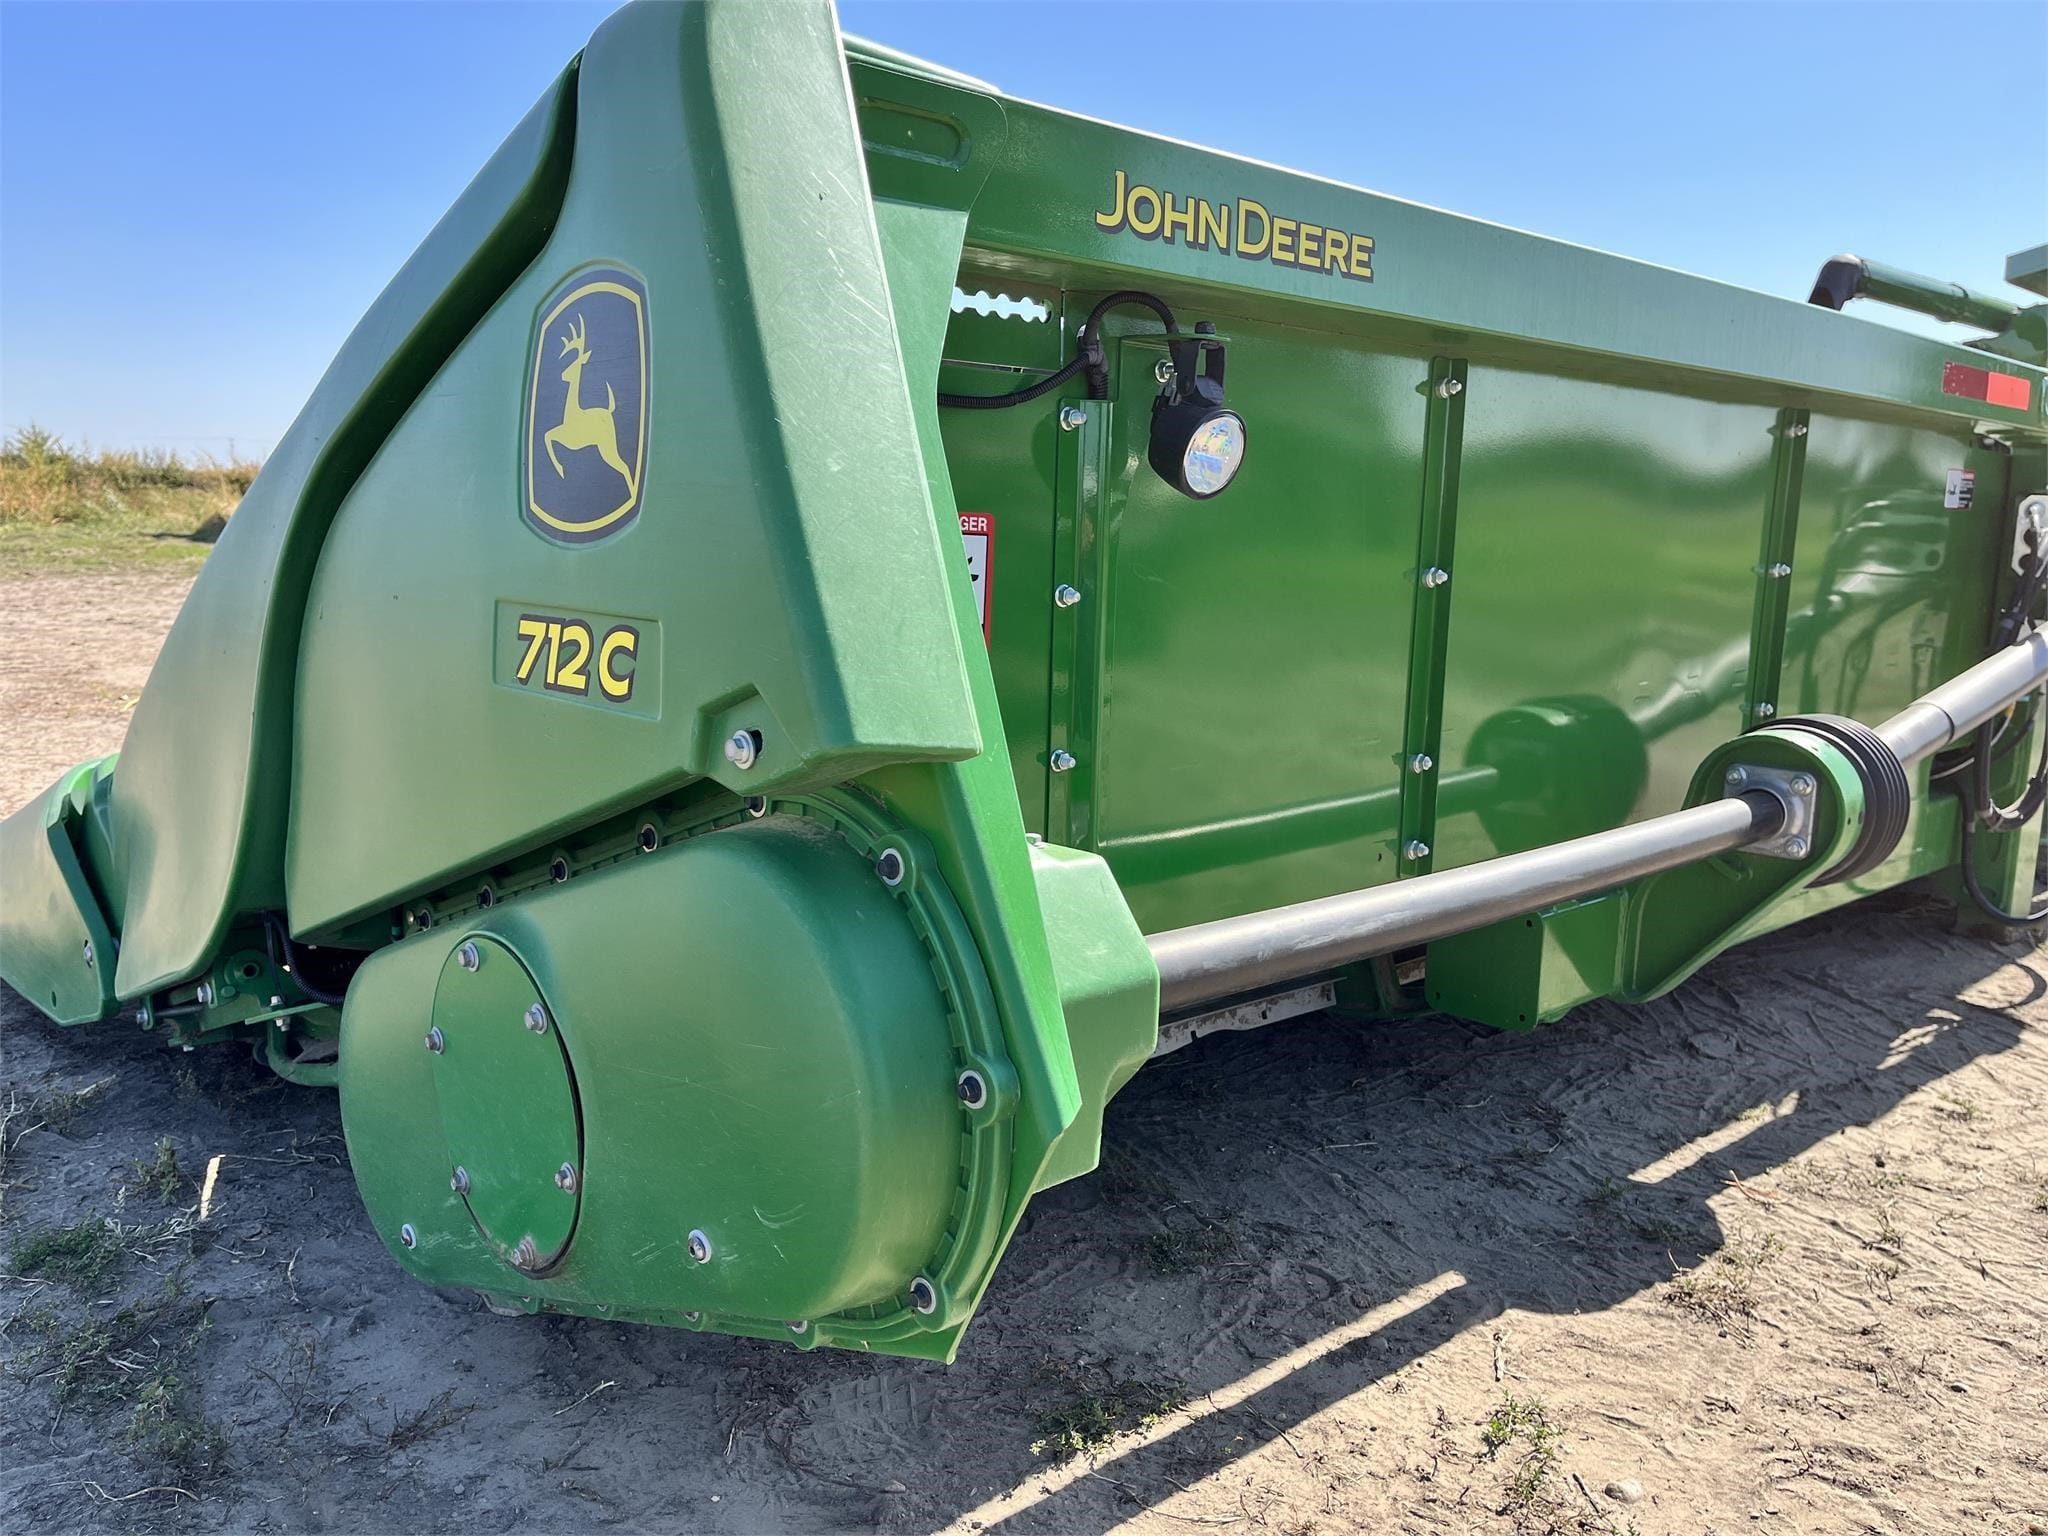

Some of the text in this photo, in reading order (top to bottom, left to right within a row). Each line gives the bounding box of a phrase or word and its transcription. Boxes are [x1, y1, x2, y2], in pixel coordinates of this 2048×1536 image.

[1095, 169, 1375, 283] JOHN DEERE
[959, 515, 988, 532] GER
